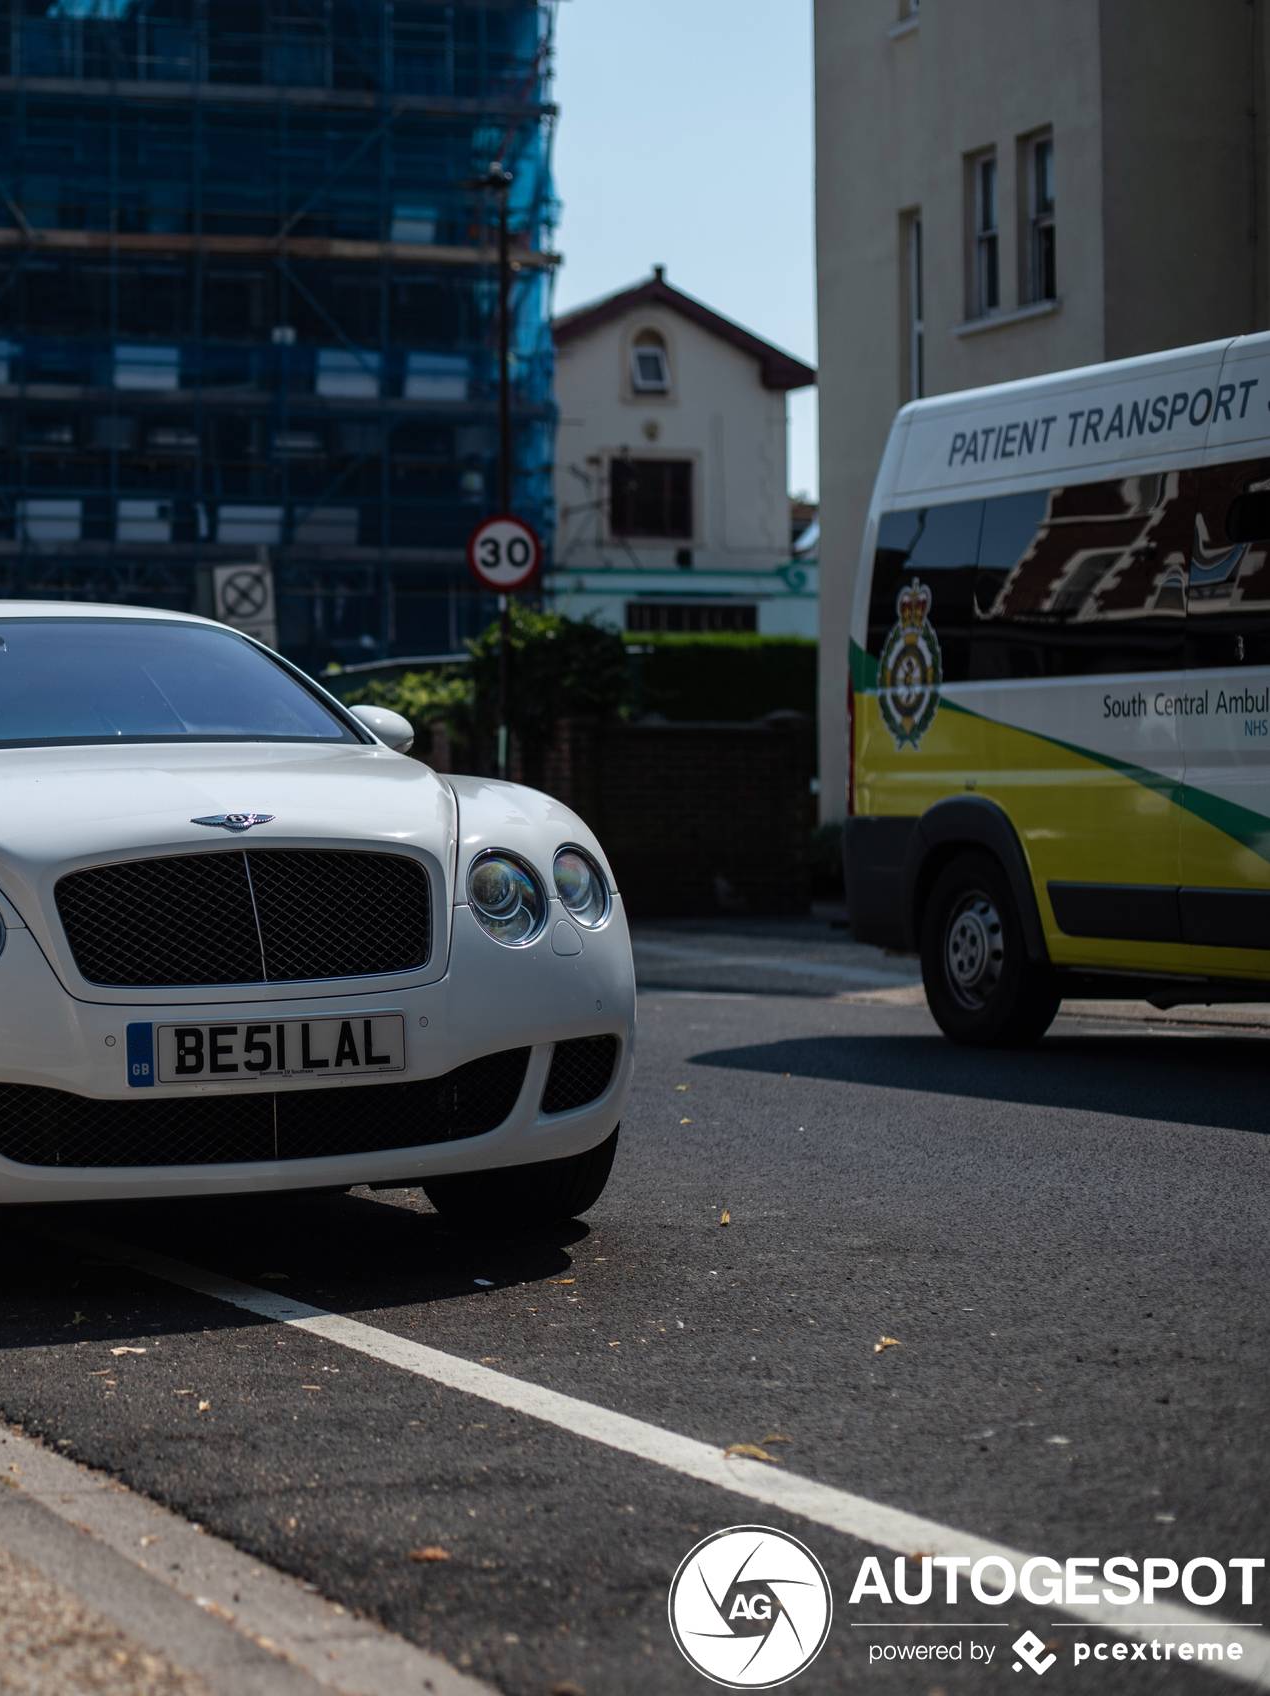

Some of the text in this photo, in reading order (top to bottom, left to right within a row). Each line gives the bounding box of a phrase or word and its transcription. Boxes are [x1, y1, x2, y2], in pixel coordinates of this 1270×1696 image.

[947, 379, 1259, 467] PATIENT TRANSPORT
[480, 537, 530, 568] 30
[1103, 692, 1147, 719] South
[1154, 688, 1208, 716] Central
[1245, 719, 1268, 737] NHS
[301, 1019, 391, 1069] LAL
[132, 1063, 150, 1076] GB
